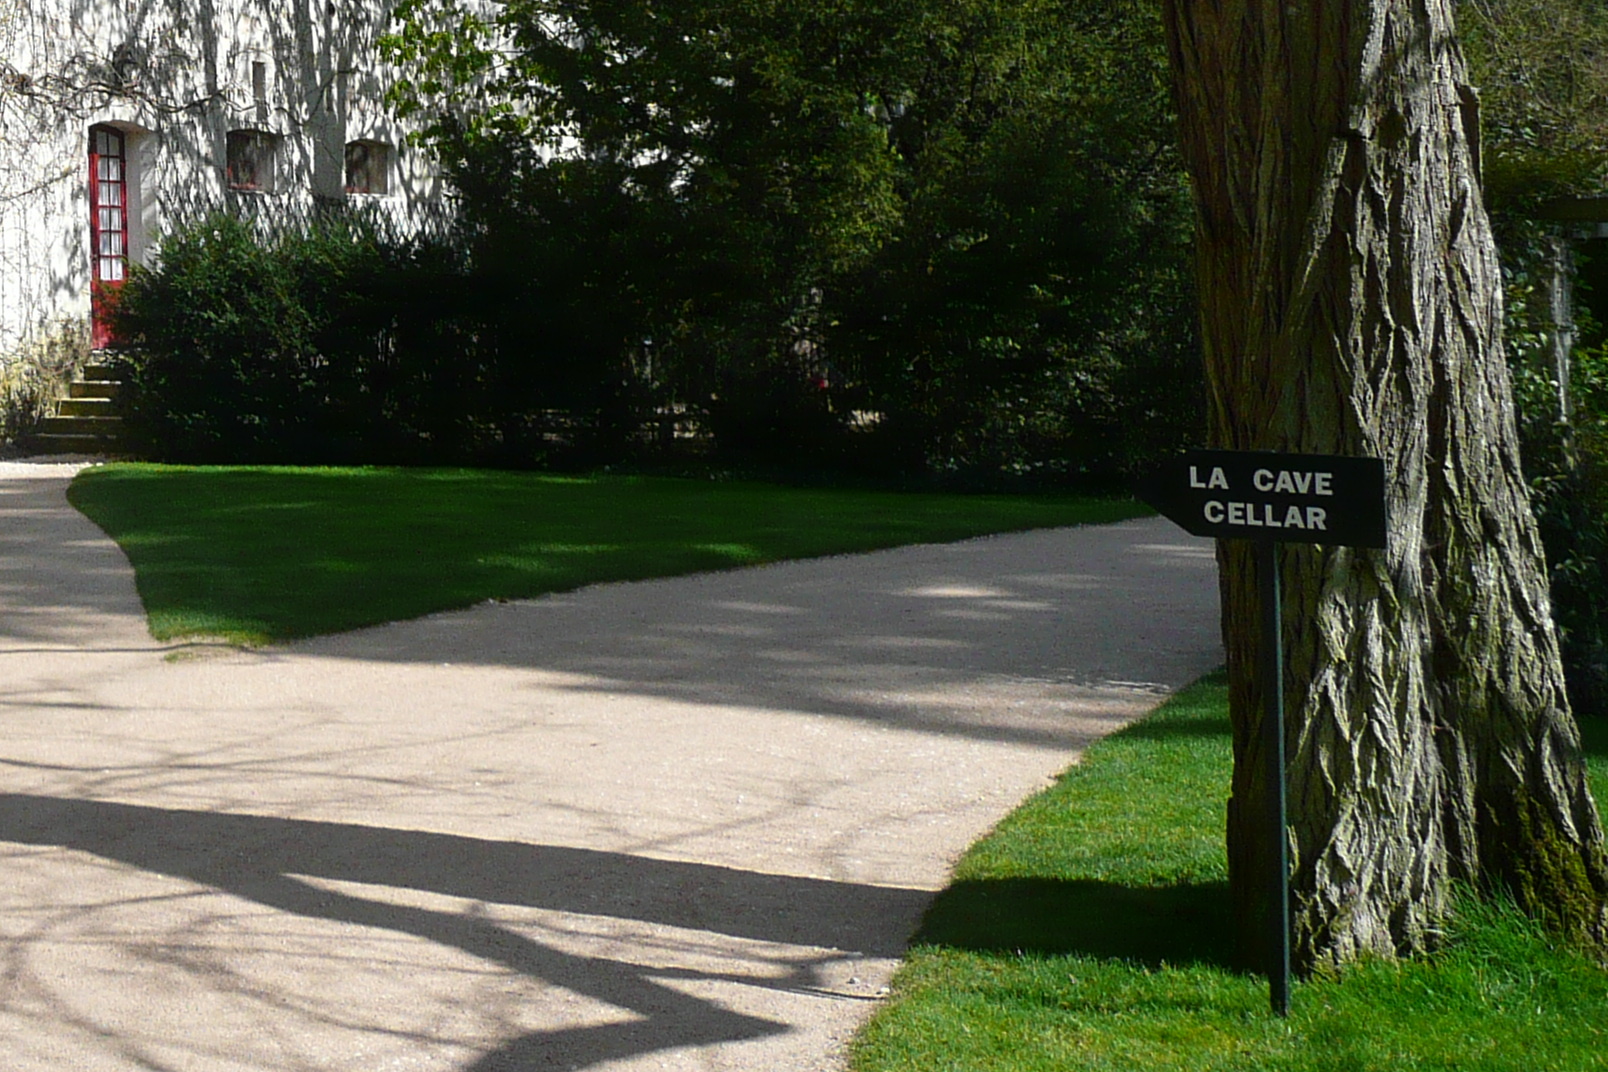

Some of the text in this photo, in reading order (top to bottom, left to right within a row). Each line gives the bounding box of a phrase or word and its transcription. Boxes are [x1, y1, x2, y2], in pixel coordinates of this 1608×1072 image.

[1189, 465, 1334, 495] LA CAVE
[1203, 500, 1326, 531] CELLAR
